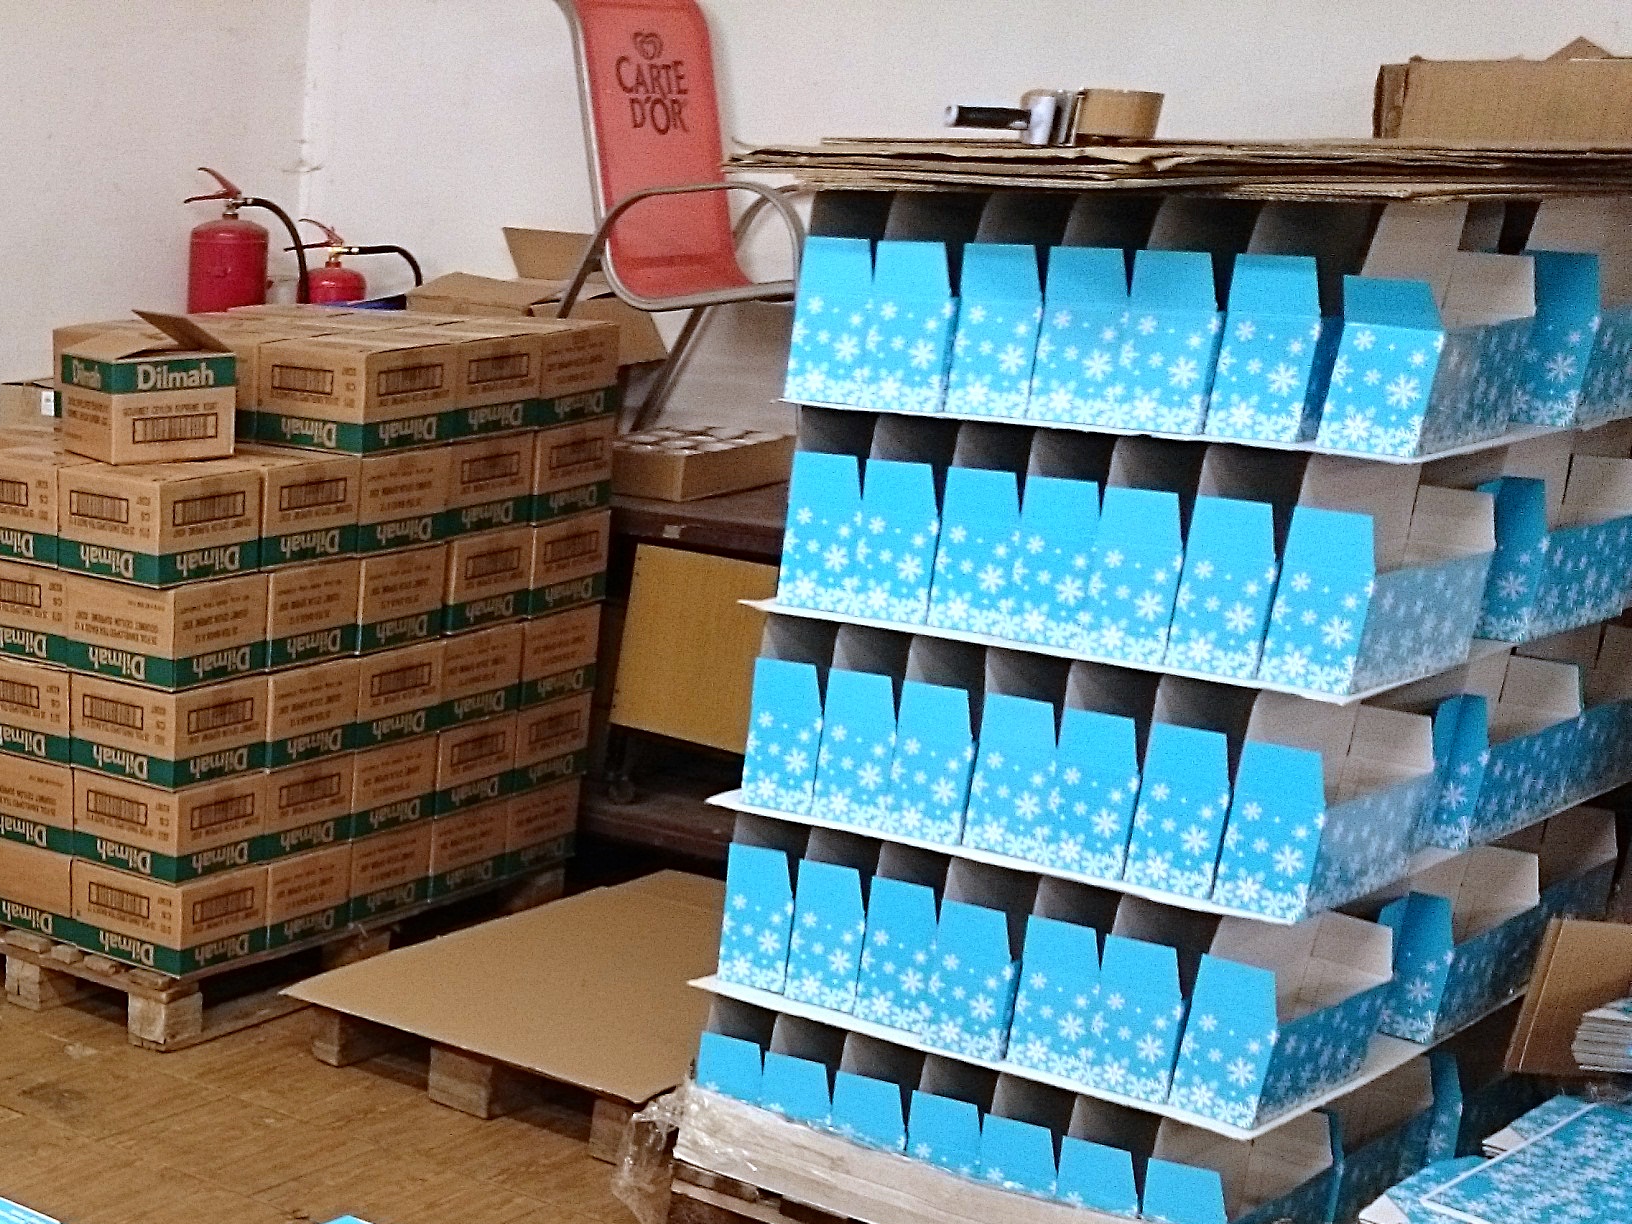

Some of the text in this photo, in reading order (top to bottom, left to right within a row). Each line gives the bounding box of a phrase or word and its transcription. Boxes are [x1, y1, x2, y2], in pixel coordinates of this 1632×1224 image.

[615, 55, 688, 97] CARTE
[630, 97, 690, 135] D'OR
[137, 362, 214, 390] Dilmah
[468, 403, 523, 430] Dilmah
[555, 391, 604, 417] Dilmah
[281, 416, 336, 447] Dilmah
[379, 416, 436, 445] Dilmah
[462, 503, 512, 527] Dilmah
[376, 518, 432, 543] Dilmah
[280, 530, 339, 560] Dilmah
[81, 545, 134, 578] Dilmah
[177, 546, 240, 583] Dilmah
[466, 595, 513, 619] Dilmah
[376, 615, 426, 639] Dilmah
[287, 630, 341, 654] Dilmah
[89, 646, 145, 680] Dilmah
[193, 649, 250, 675] Dilmah
[455, 692, 505, 718] Dilmah
[373, 711, 425, 735] Dilmah
[287, 730, 342, 754] Dilmah
[93, 744, 148, 779] Dilmah
[190, 748, 247, 778] Dilmah
[451, 778, 497, 806] Dilmah
[369, 800, 421, 828] Dilmah
[280, 821, 335, 848] Dilmah
[97, 839, 151, 874] Dilmah
[193, 842, 248, 872] Dilmah
[3, 902, 53, 934] Dilmah
[100, 930, 154, 966] Dilmah
[195, 934, 248, 965] Dilmah
